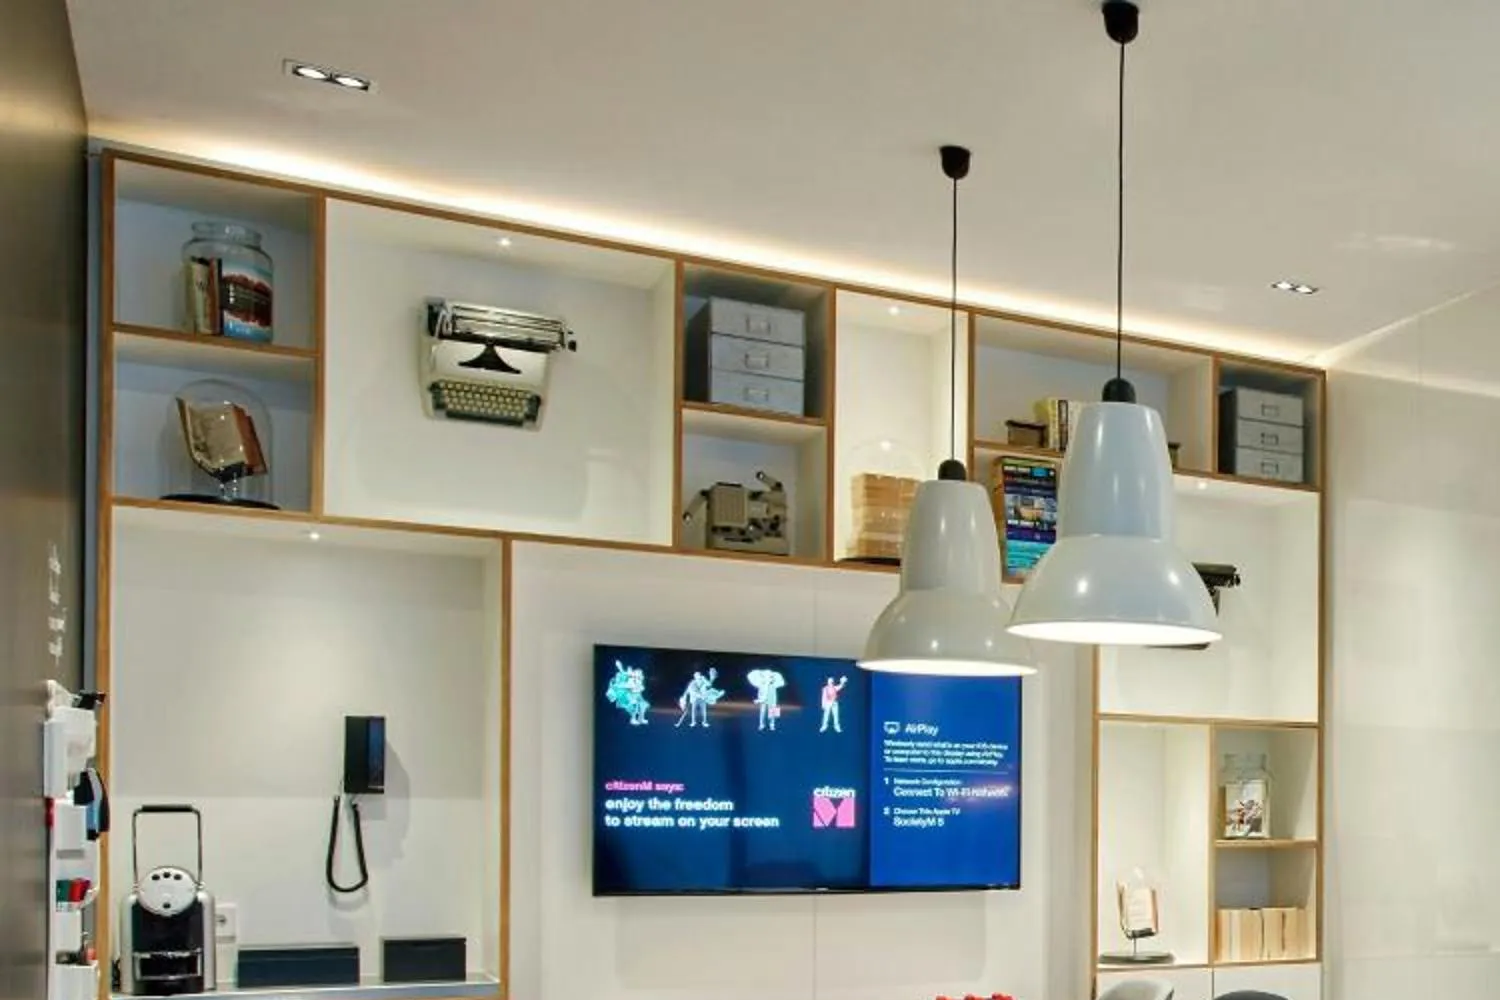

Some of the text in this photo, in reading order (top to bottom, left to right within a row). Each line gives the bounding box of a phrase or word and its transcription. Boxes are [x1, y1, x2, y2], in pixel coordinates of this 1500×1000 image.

[905, 723, 939, 736] AirPlay
[814, 786, 855, 798] citizen
[605, 797, 734, 812] enjoy the freedom
[605, 814, 780, 830] to stream on your screen
